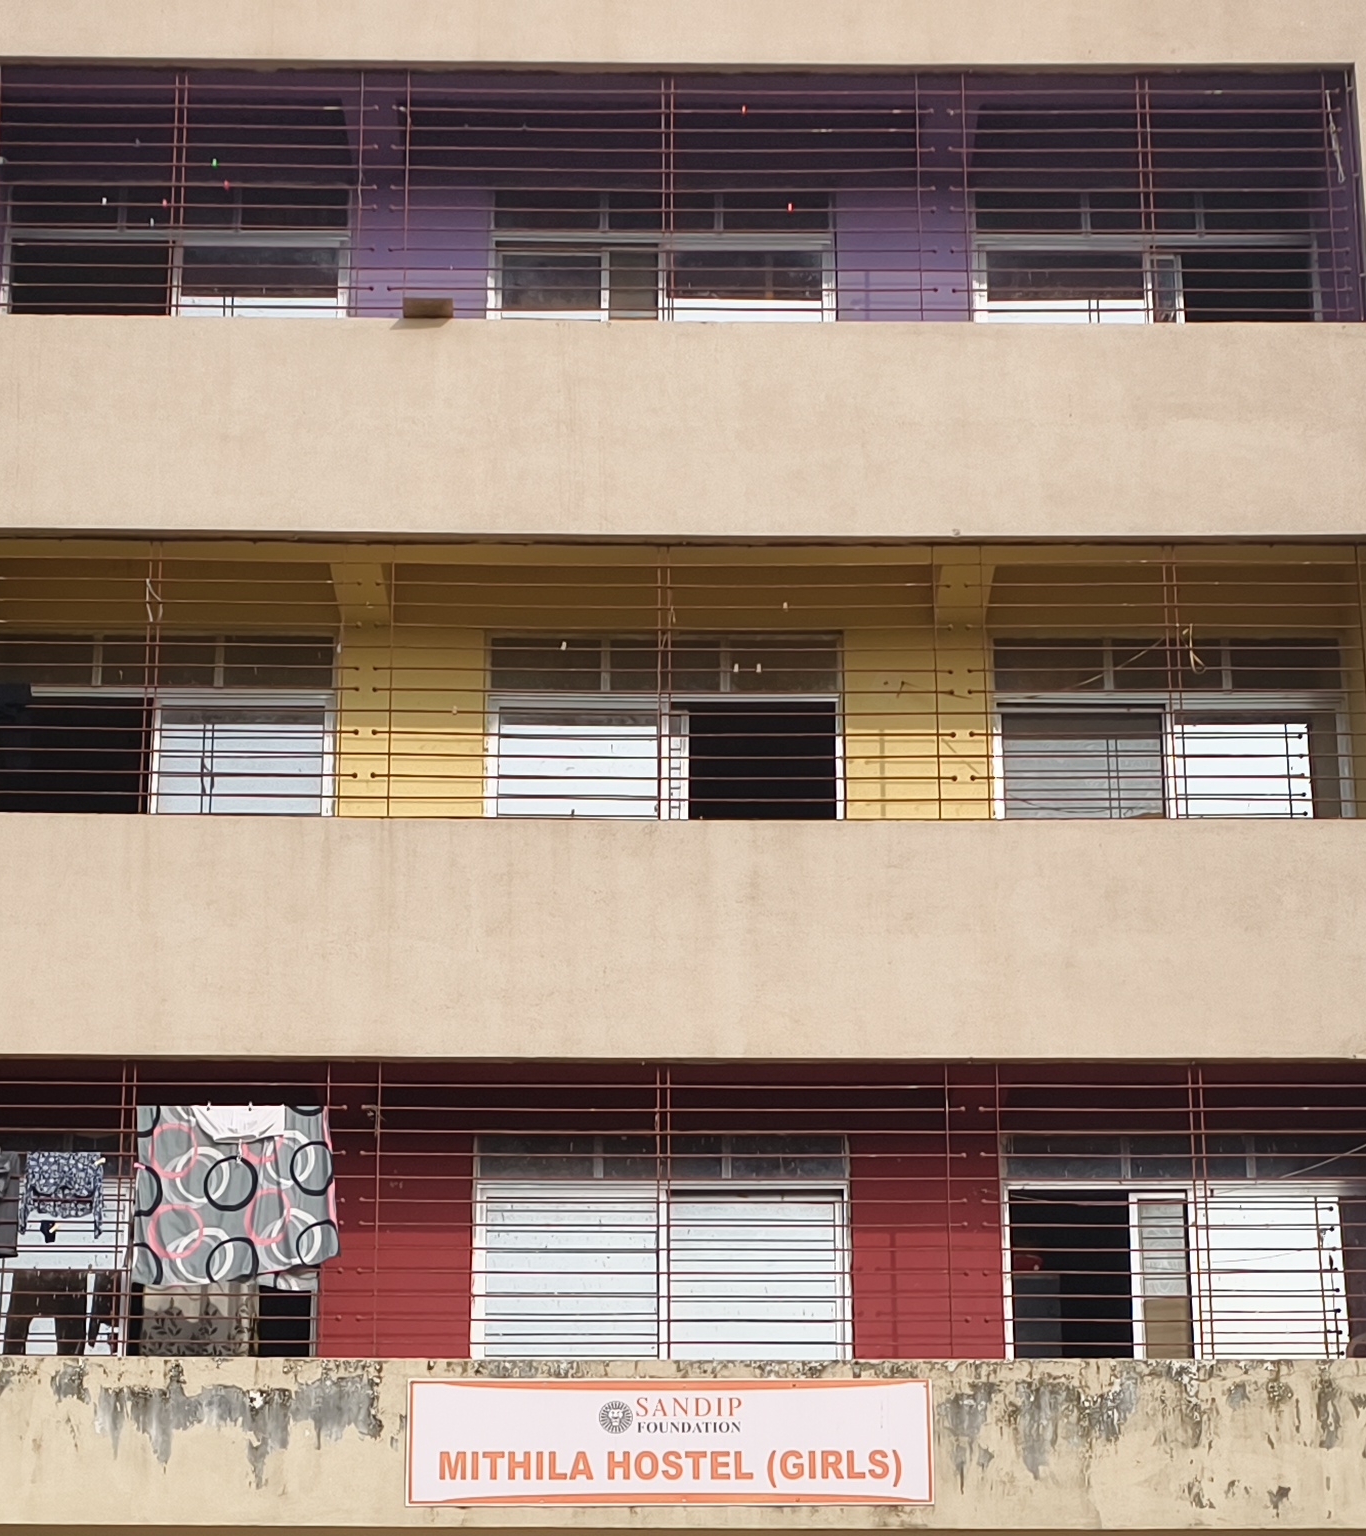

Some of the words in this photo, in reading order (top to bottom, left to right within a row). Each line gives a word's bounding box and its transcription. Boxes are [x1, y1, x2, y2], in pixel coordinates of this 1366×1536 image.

[636, 1397, 742, 1418] SANDIP
[637, 1421, 741, 1434] FOUNDATION
[438, 1450, 595, 1481] MITHILA
[607, 1450, 754, 1481] HOSTEL
[766, 1449, 903, 1488] (GIRLS)
